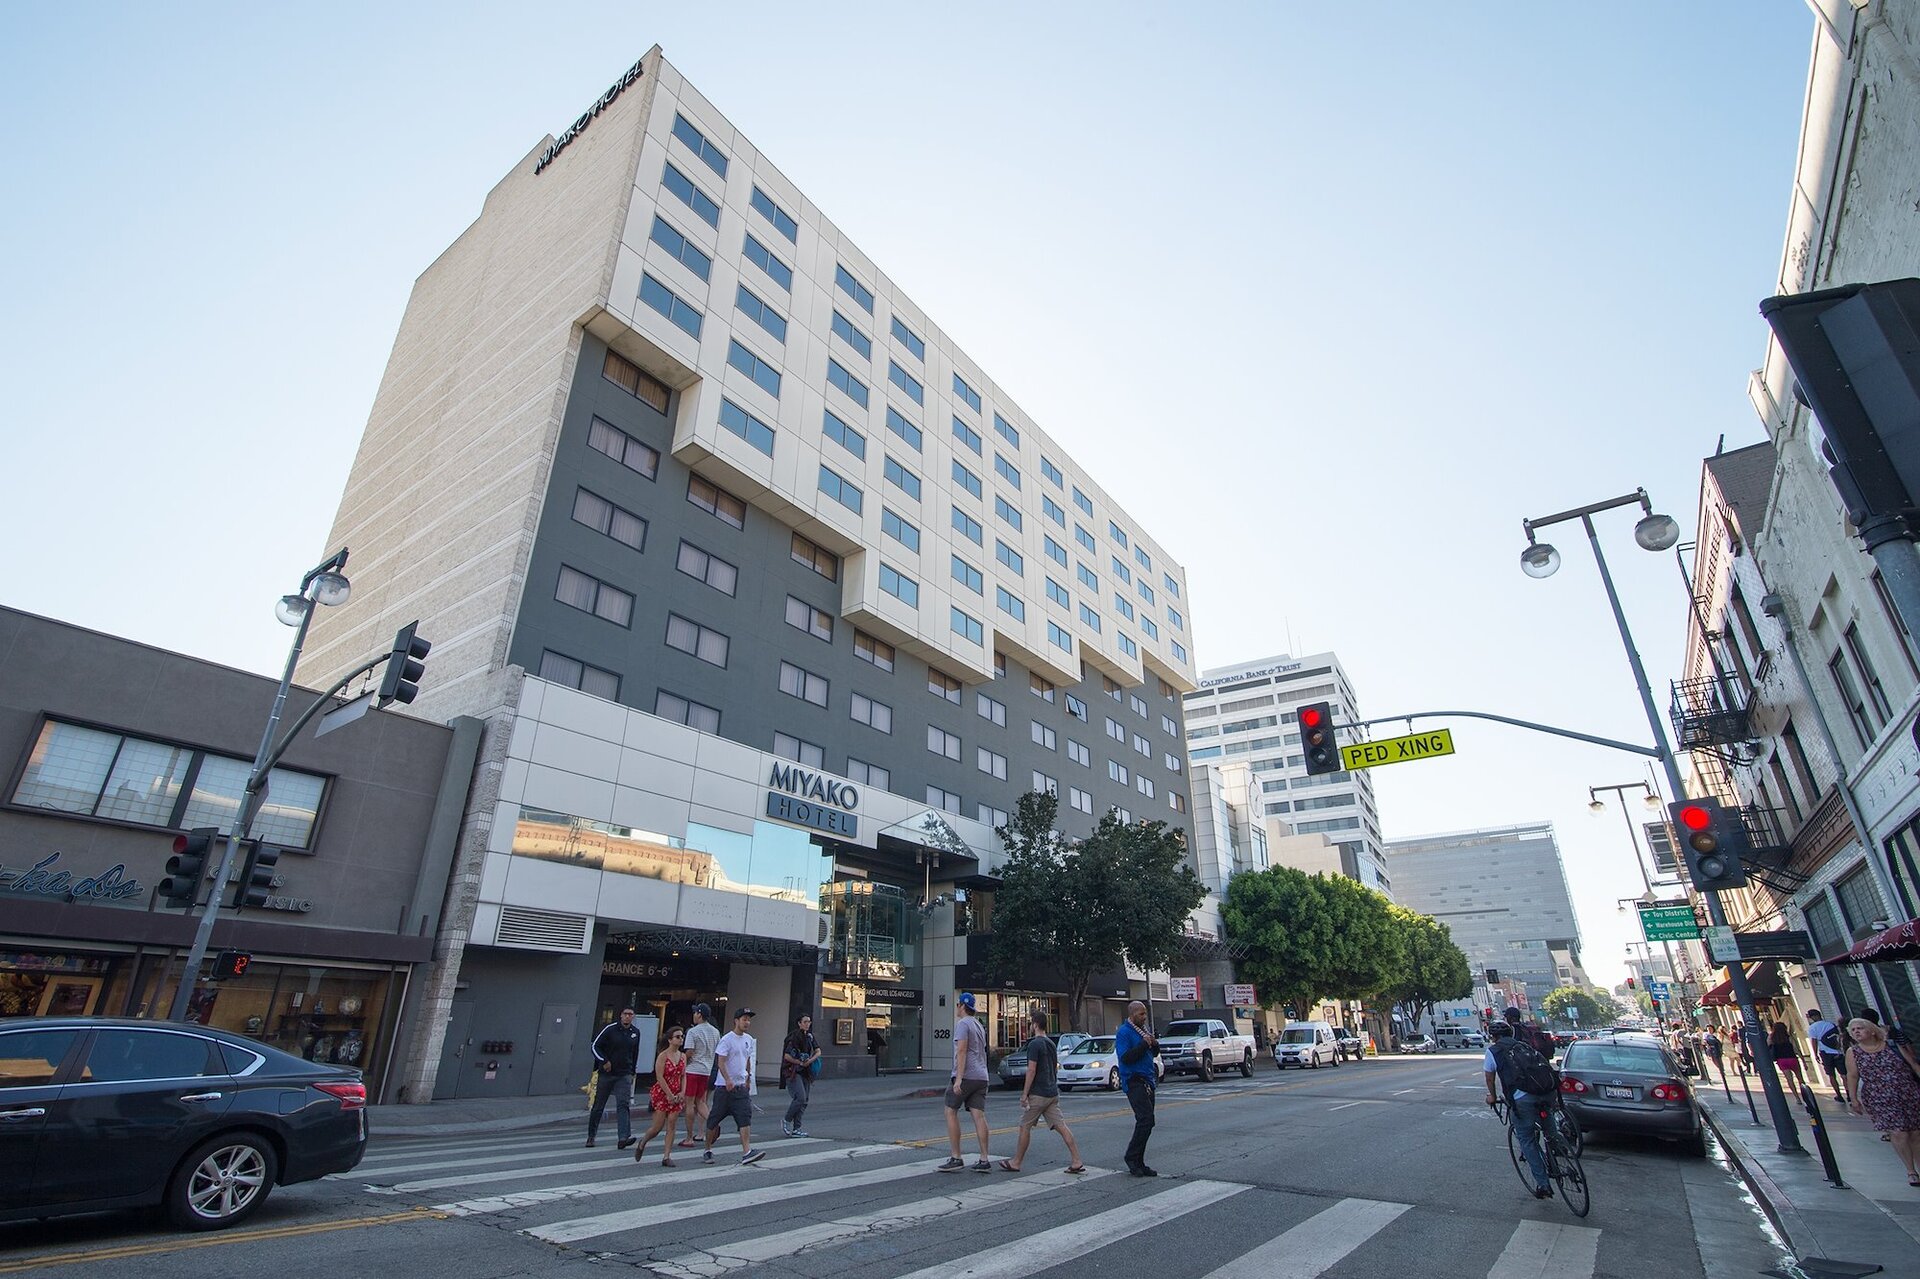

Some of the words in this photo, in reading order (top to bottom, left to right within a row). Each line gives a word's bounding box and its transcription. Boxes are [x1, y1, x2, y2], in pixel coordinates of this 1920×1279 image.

[534, 111, 592, 175] MIYAKO
[594, 60, 644, 117] HOTEL
[1201, 674, 1244, 688] CALIFORNIA
[1246, 670, 1267, 679] BANK
[1268, 667, 1275, 675] &
[1275, 663, 1301, 673] TRUST
[1351, 745, 1388, 765] PED
[1397, 735, 1443, 757] XING
[769, 761, 858, 810] MIYAKO
[781, 798, 847, 832] HOTEL
[602, 961, 644, 975] ARANCE
[876, 989, 889, 997] HOTEL
[898, 990, 915, 998] ANGELES
[934, 1030, 951, 1039] 328
